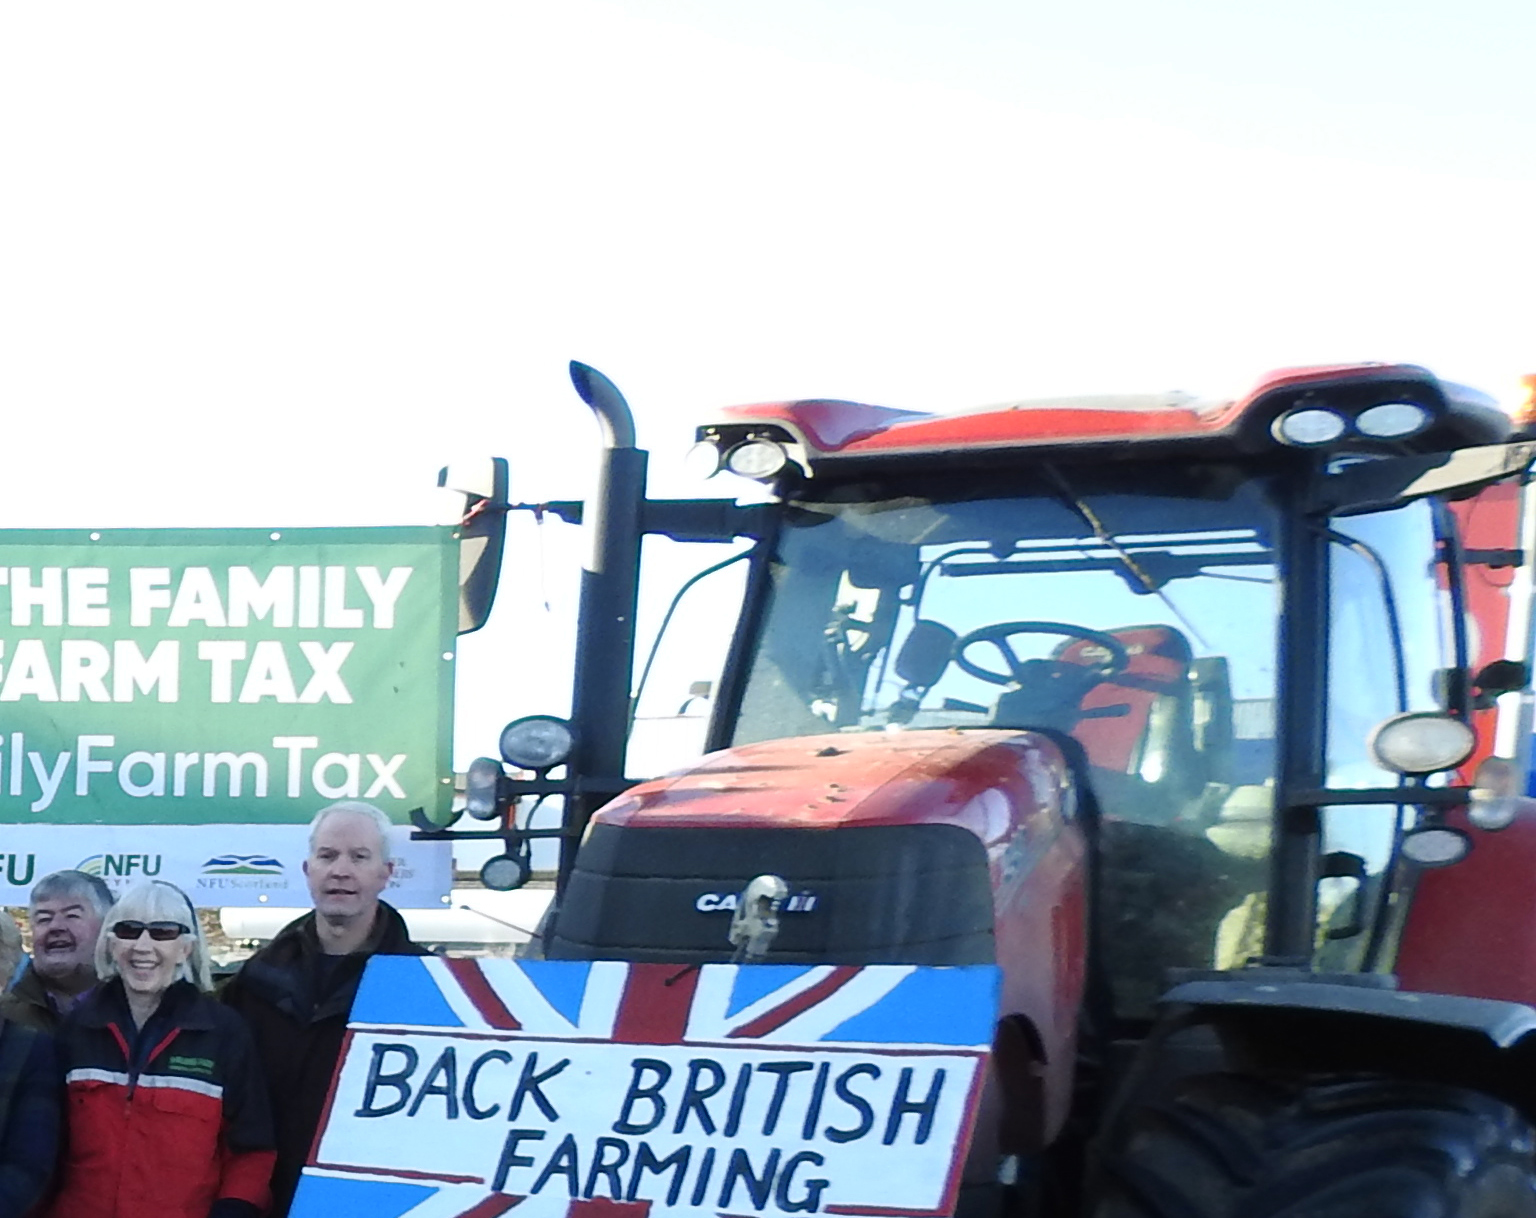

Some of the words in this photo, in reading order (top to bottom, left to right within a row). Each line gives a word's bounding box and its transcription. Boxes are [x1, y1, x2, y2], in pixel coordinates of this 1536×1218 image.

[130, 566, 414, 629] FAMILY
[198, 640, 355, 704] TAX
[104, 853, 162, 876] NFU
[354, 1043, 571, 1122] BACK
[612, 1057, 948, 1145] BRITISH
[491, 1128, 832, 1215] FARMING
